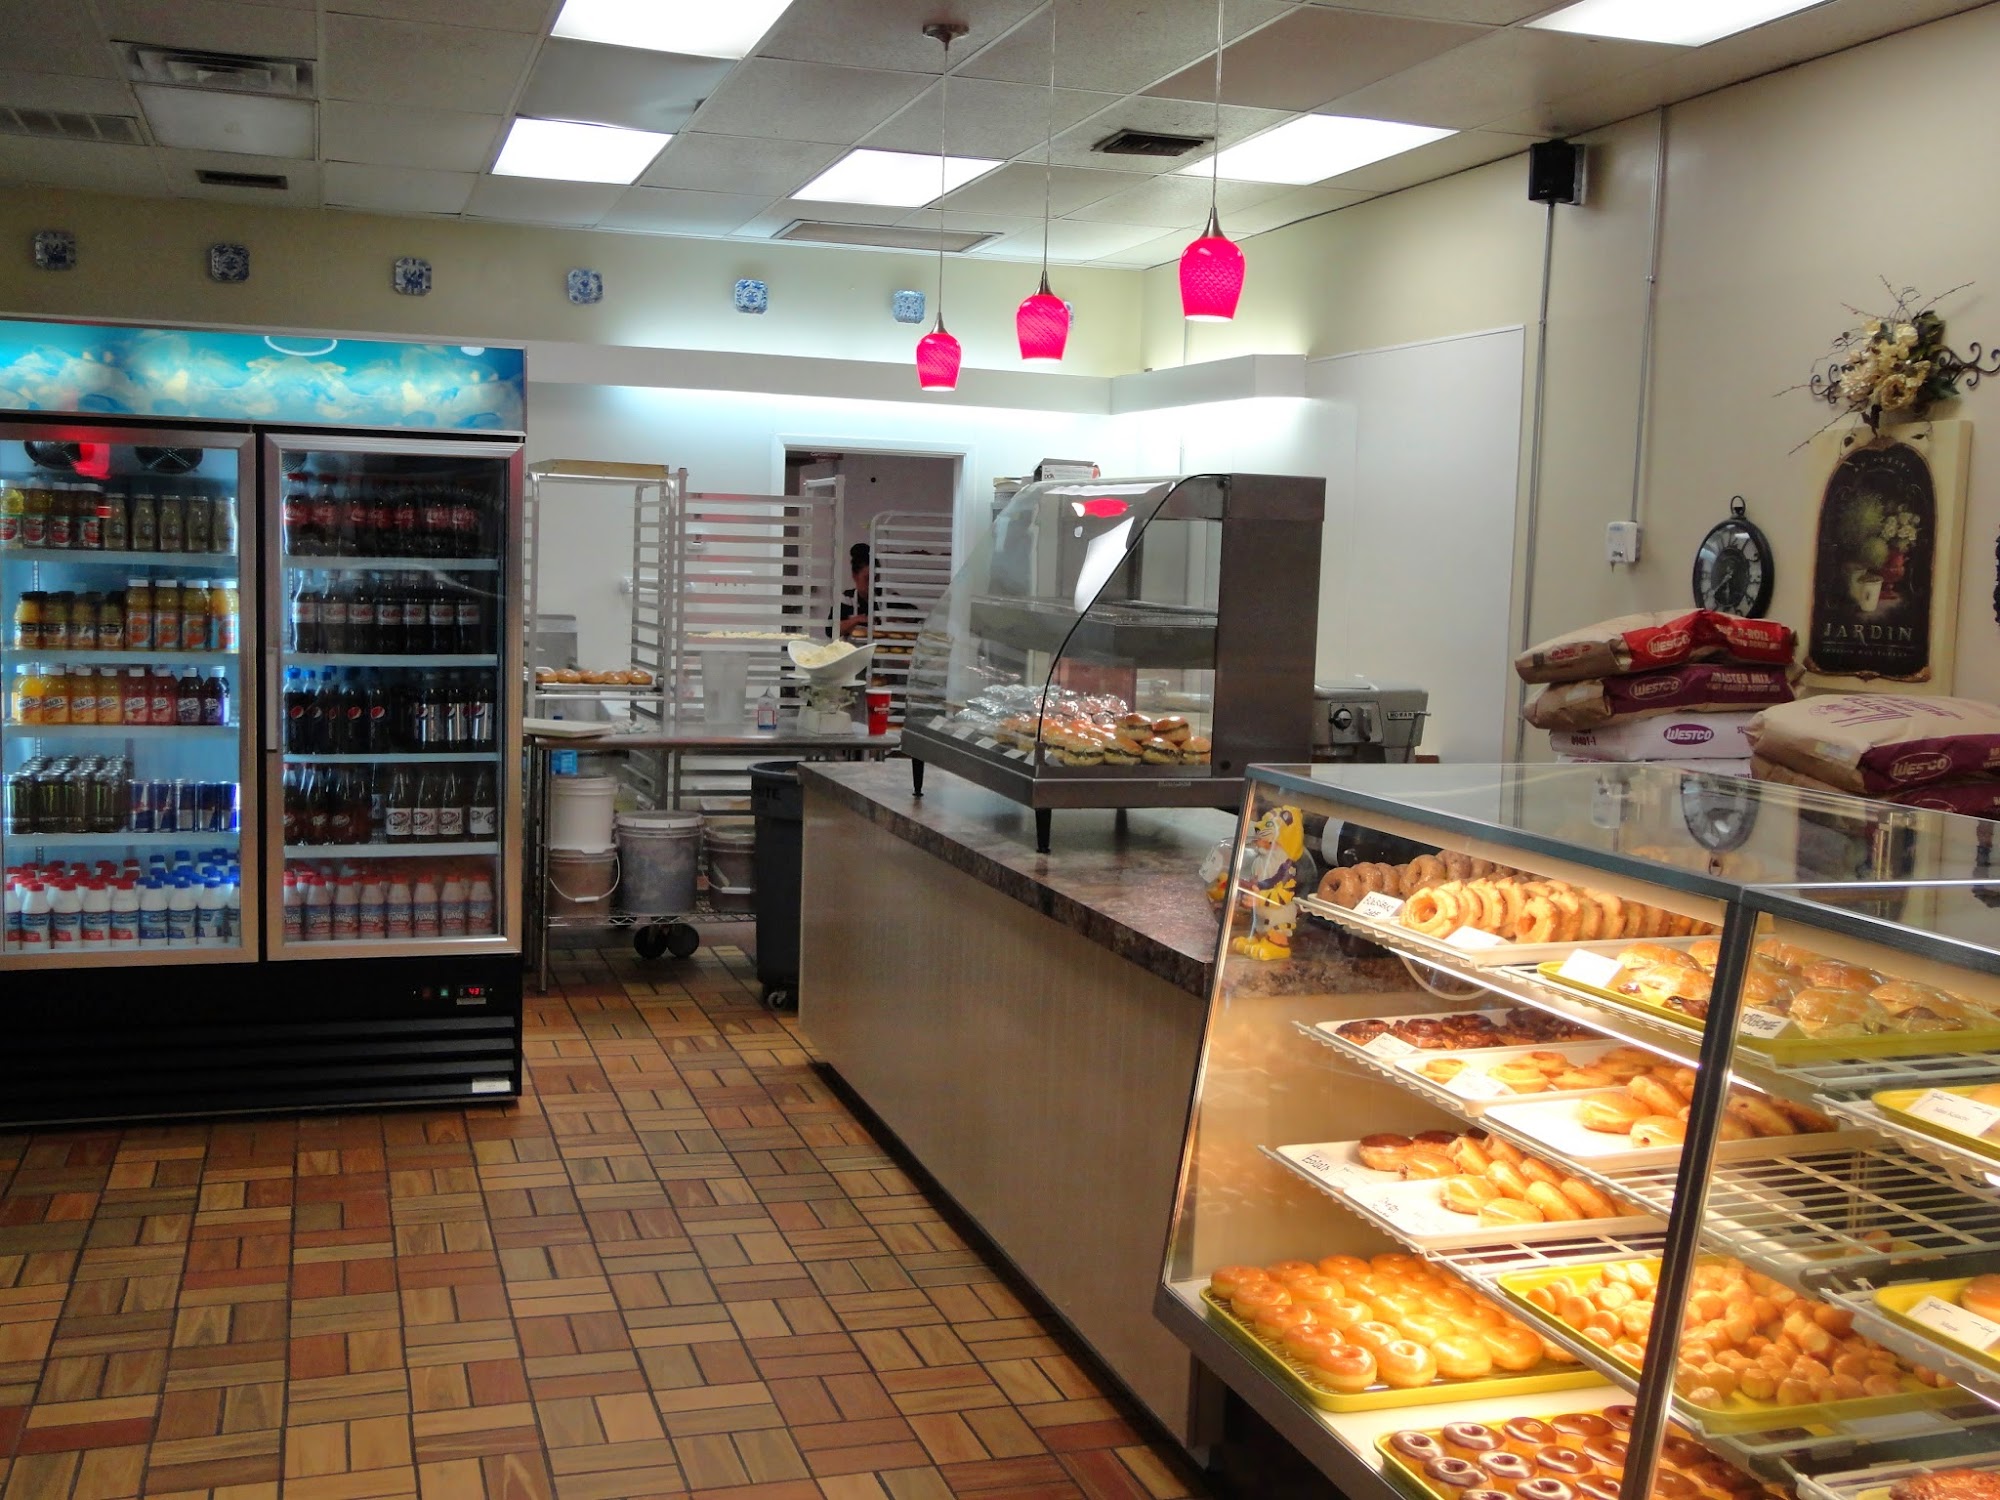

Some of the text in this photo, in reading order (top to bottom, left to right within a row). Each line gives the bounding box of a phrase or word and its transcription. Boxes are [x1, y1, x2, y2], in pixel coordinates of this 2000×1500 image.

[1823, 622, 1912, 646] JARDIN
[1650, 633, 1691, 653] WESTCO
[1710, 672, 1770, 684] MASTER MIX
[1633, 680, 1679, 698] WESTCO
[1666, 727, 1712, 741] WESTCO
[468, 987, 480, 995] 43
